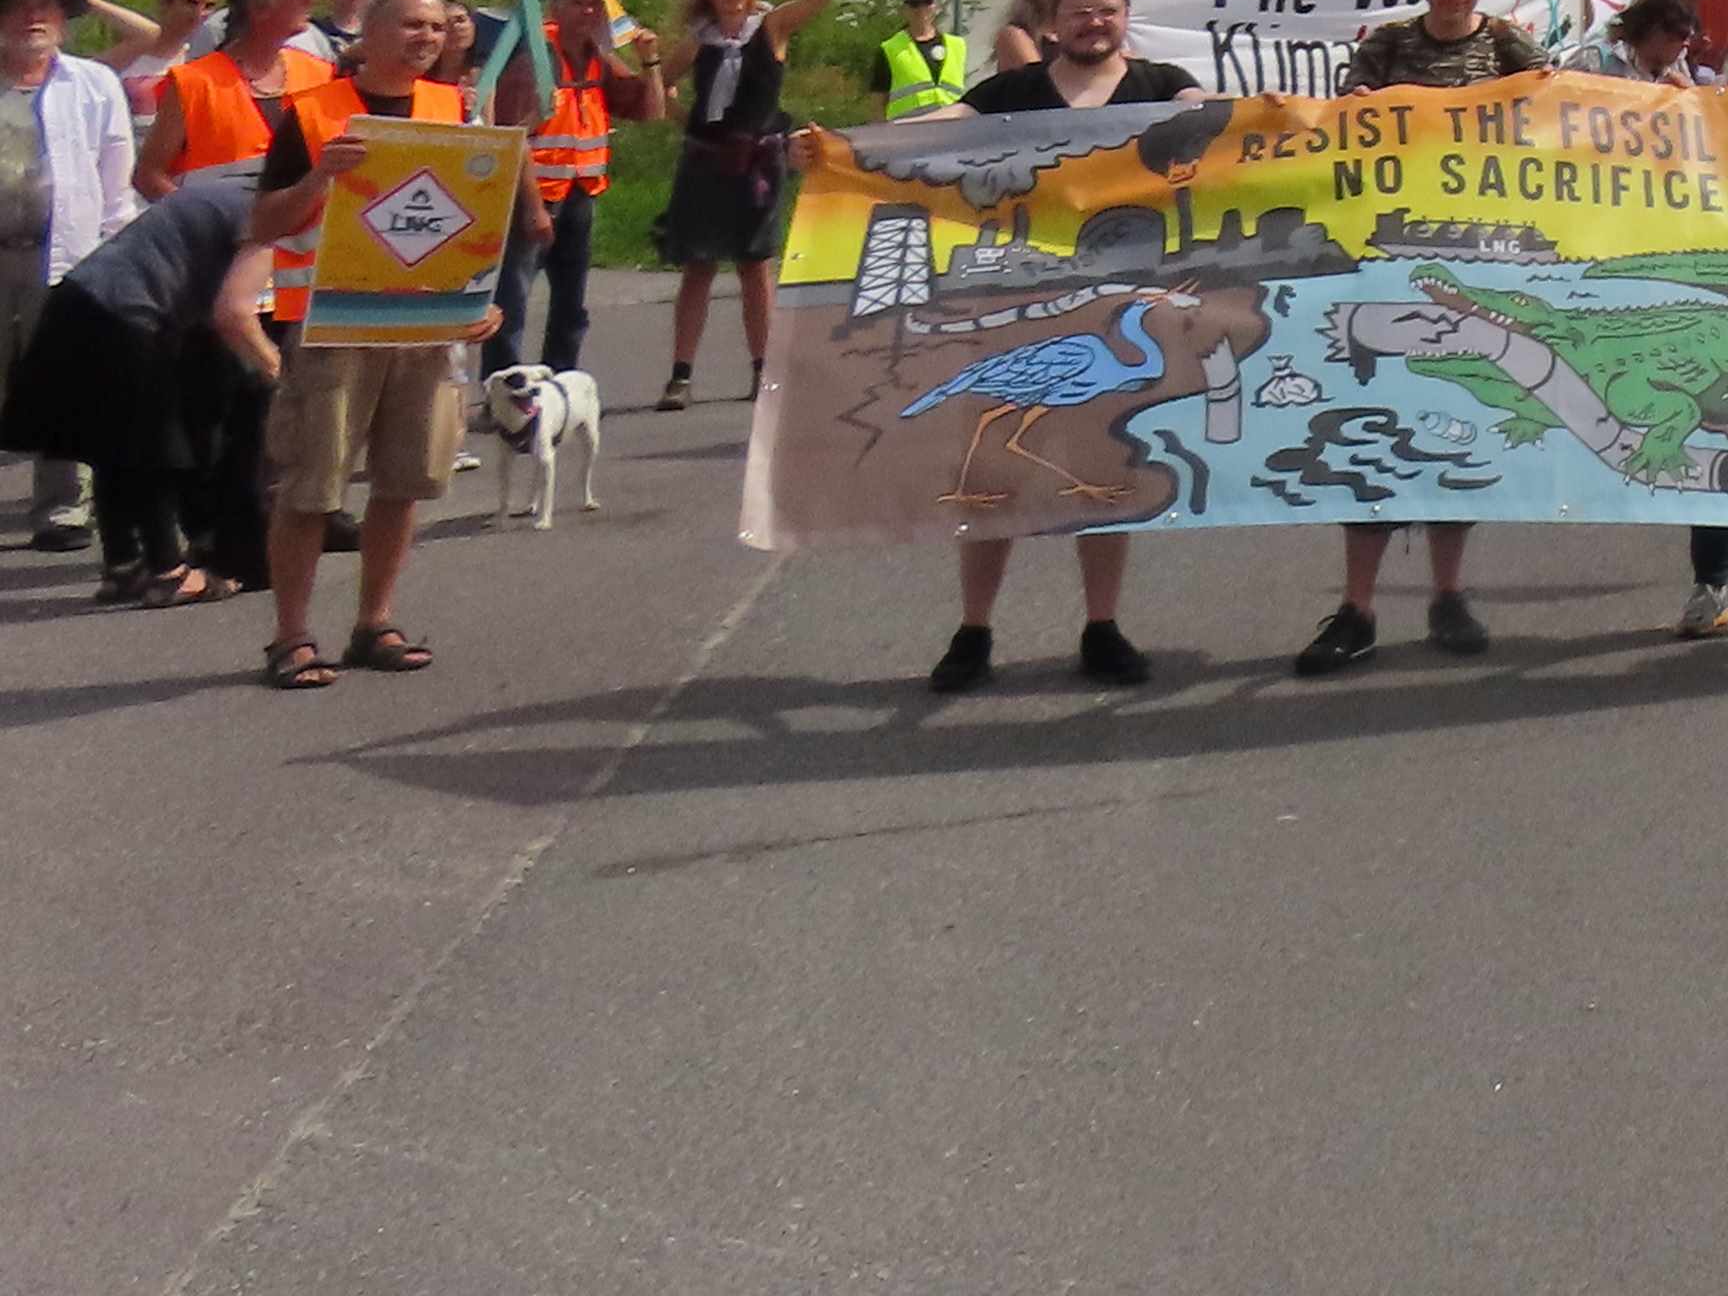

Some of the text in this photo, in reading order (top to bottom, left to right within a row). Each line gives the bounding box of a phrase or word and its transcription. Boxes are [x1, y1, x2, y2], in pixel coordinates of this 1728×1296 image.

[1444, 96, 1536, 147] THE
[1561, 100, 1717, 165] FOSSIL
[1333, 154, 1403, 201] NO
[1440, 153, 1725, 213] SACRIFICE
[1479, 239, 1522, 256] LNG
